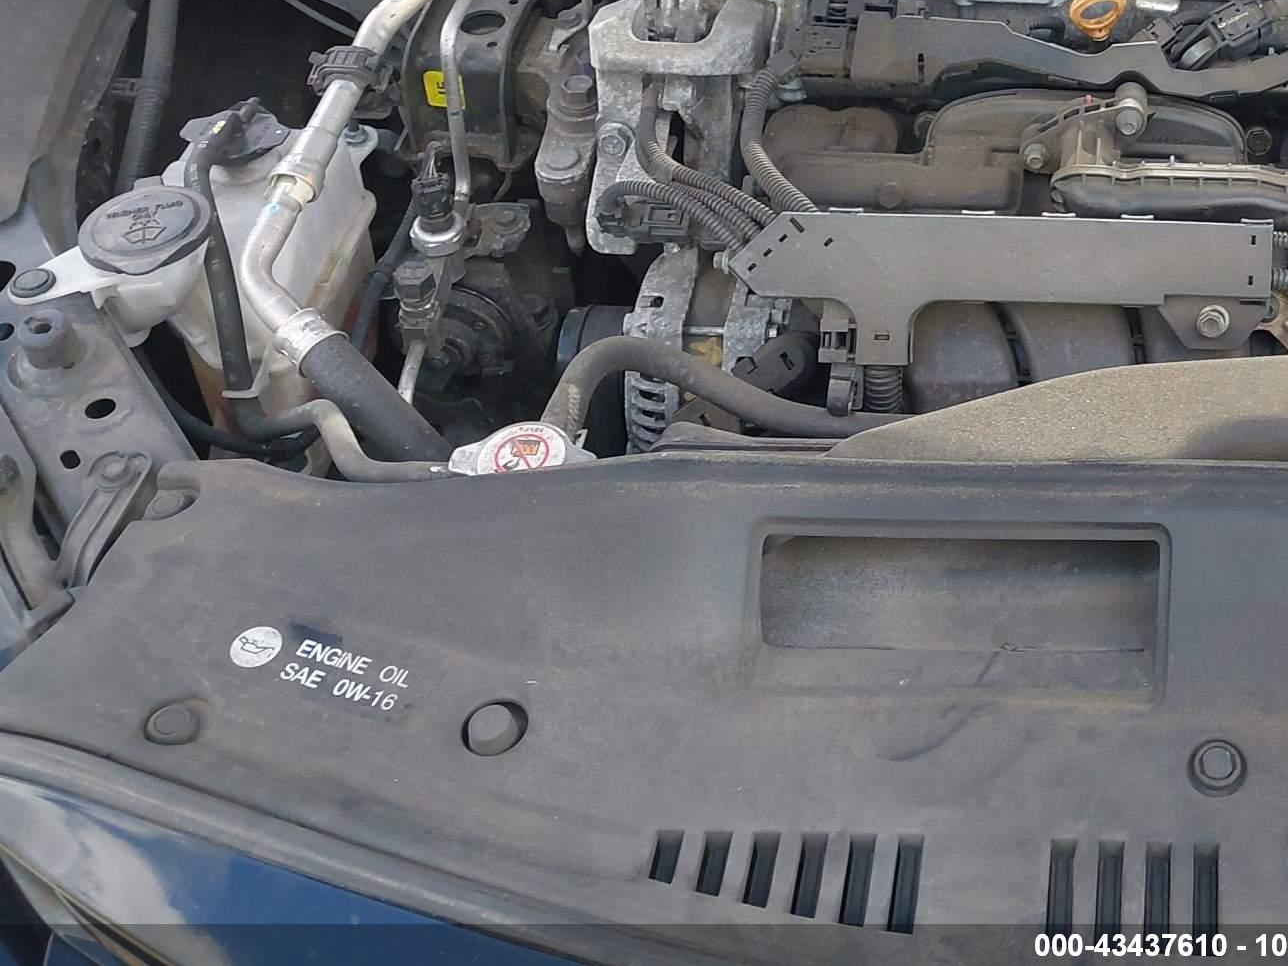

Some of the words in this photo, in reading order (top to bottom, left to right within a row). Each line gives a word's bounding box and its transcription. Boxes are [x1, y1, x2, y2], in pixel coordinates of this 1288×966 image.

[279, 662, 326, 688] SAE
[332, 679, 398, 711] 0W-16
[296, 639, 373, 675] ENGINE
[378, 665, 409, 688] OIL
